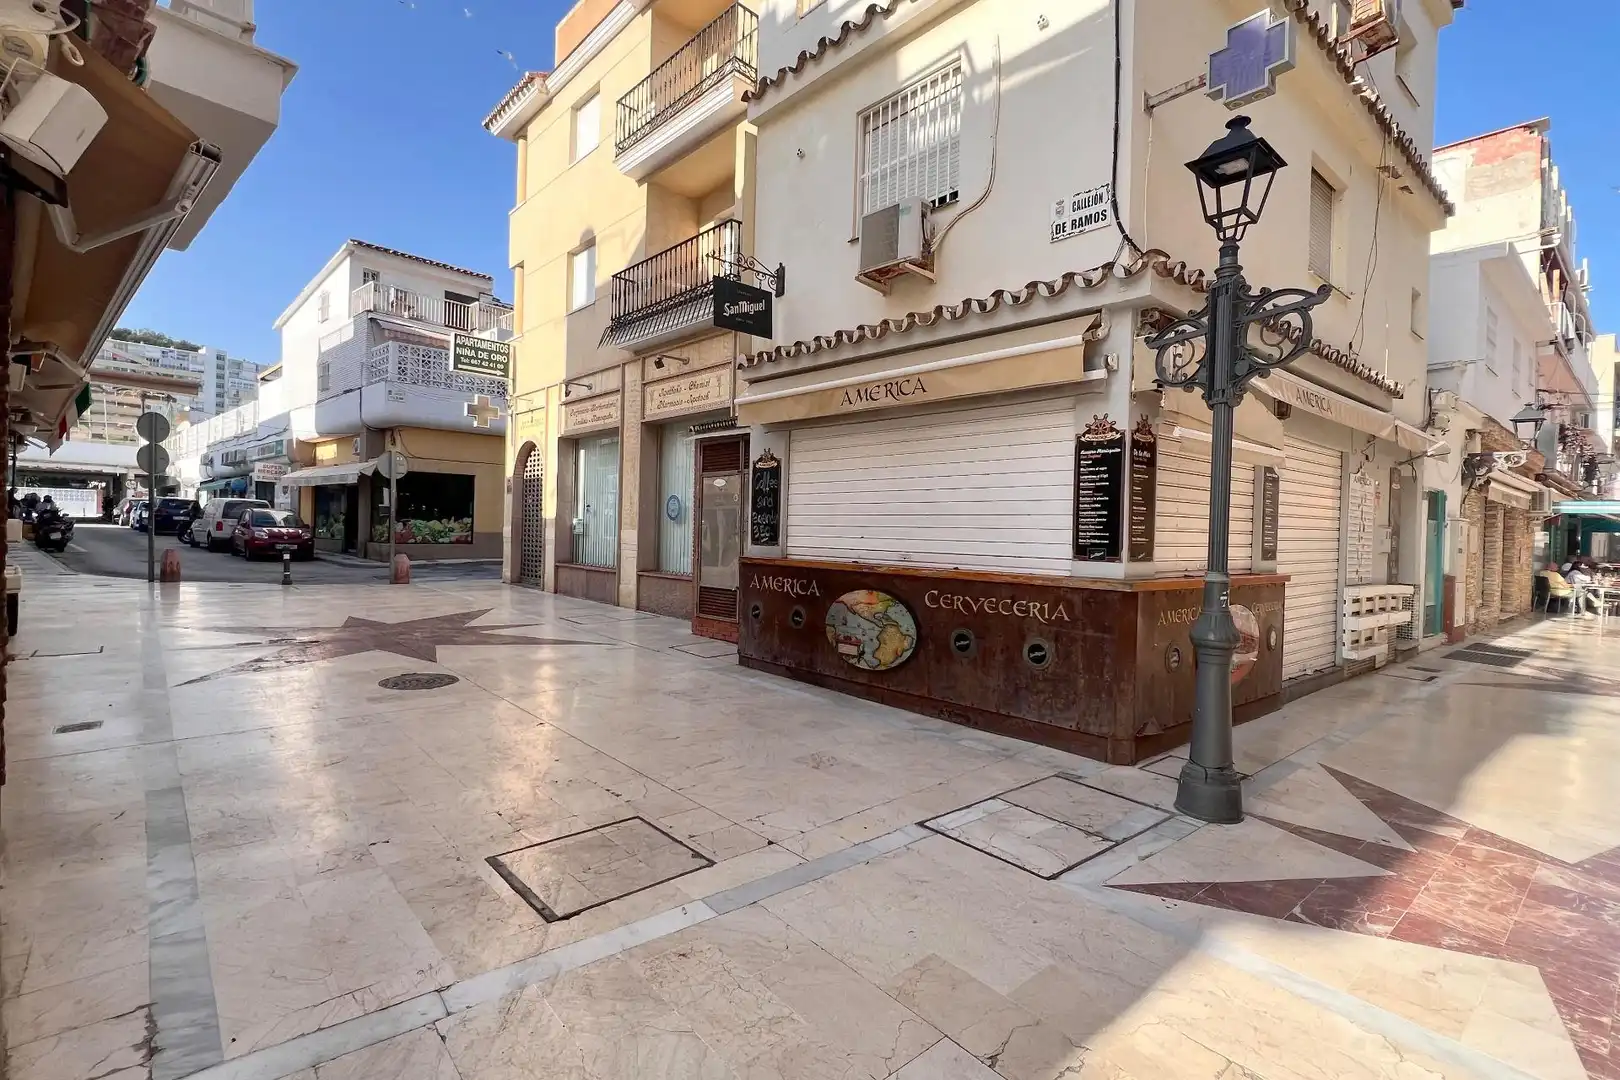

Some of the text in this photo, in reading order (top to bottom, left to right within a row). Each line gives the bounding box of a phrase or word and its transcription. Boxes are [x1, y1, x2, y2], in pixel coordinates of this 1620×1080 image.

[1072, 192, 1104, 212] CALLEJÓN
[1055, 209, 1107, 235] DE RAMOS
[456, 335, 509, 353] APARTAMENTOS
[456, 347, 508, 363] NIÑA DE ORO
[840, 377, 928, 407] AMERICA
[1296, 386, 1333, 415] AMERICA
[750, 573, 821, 599] AMERICA
[924, 590, 1071, 624] CERVECERIA
